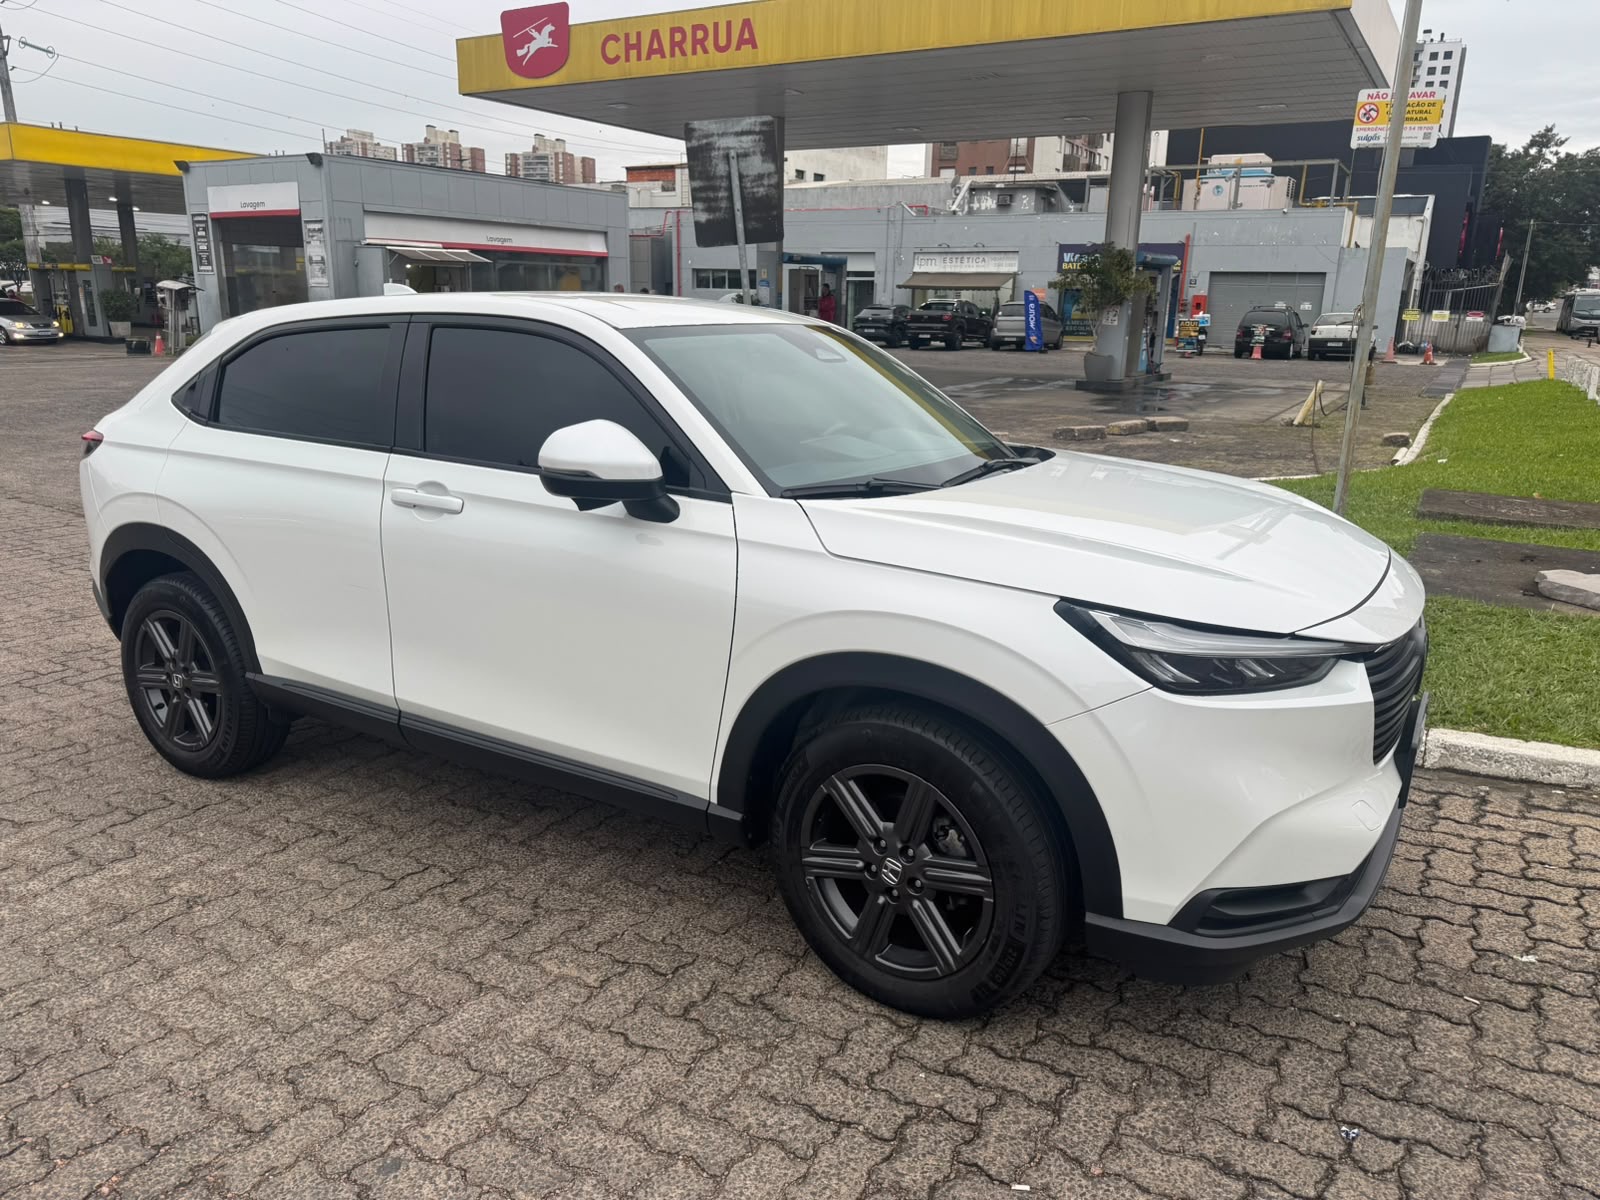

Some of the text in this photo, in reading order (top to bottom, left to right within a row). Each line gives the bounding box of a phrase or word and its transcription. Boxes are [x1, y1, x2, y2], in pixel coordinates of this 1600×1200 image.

[601, 18, 758, 65] CHARRUA
[1367, 91, 1388, 100] NÃO
[240, 201, 265, 209] Lavagem
[486, 235, 512, 244] Lavagem
[943, 256, 986, 264] ESTÉTICA
